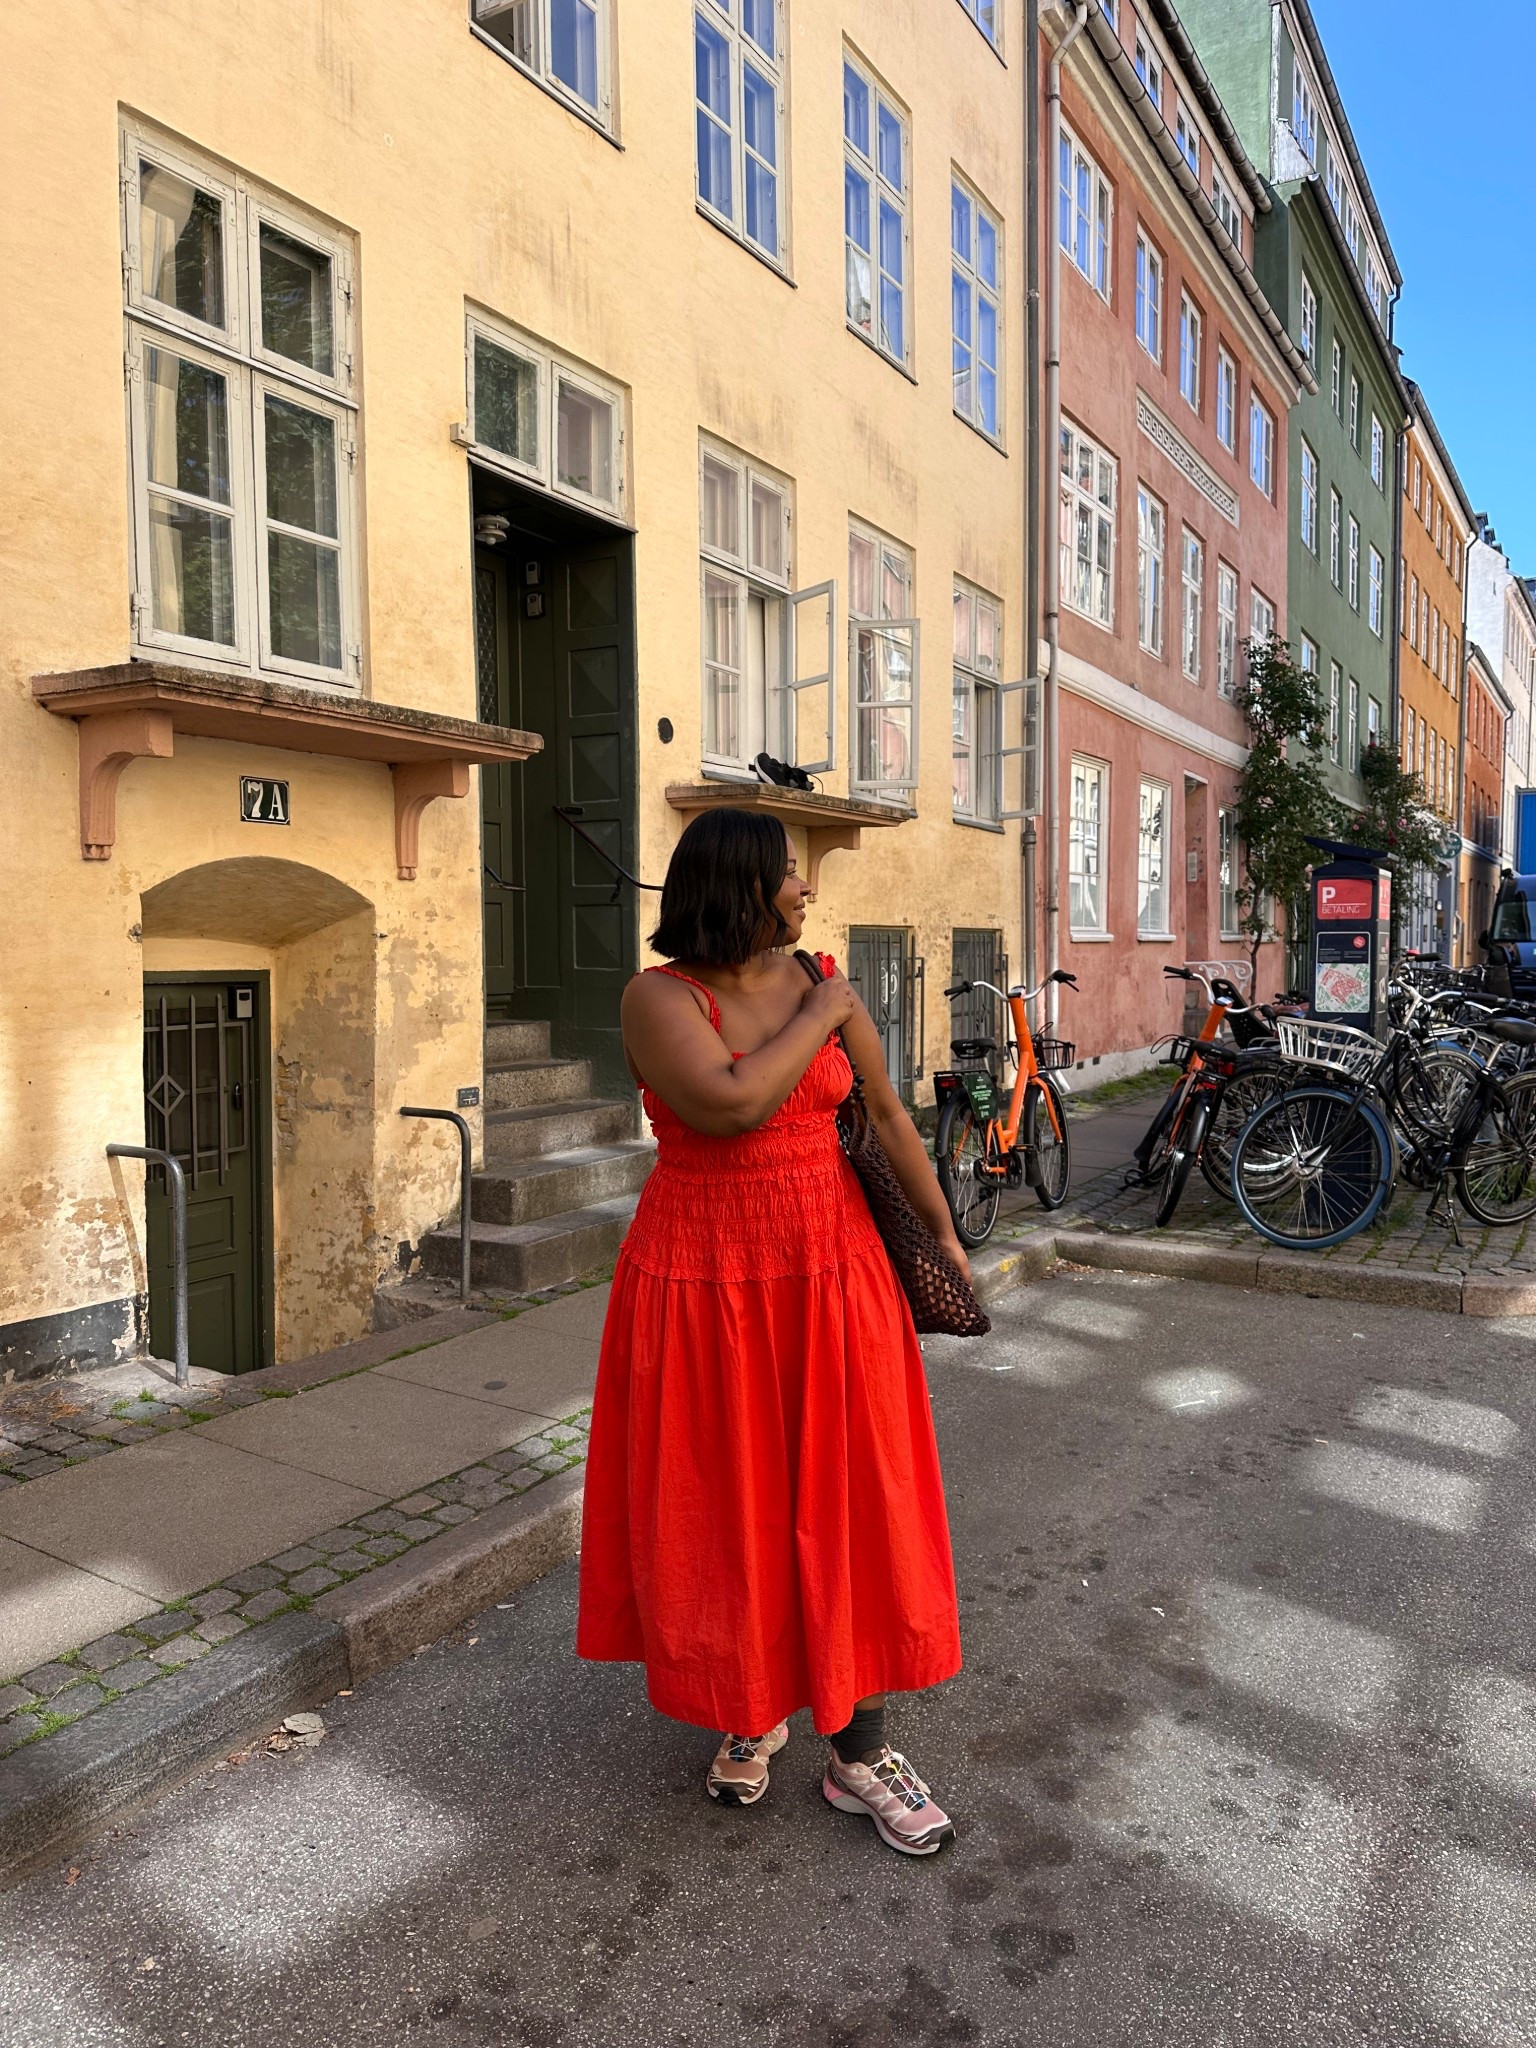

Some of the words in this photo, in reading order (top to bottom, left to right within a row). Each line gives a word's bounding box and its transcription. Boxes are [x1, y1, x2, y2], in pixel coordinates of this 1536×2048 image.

[247, 781, 286, 820] 7A
[1322, 886, 1336, 904] P
[1321, 905, 1360, 914] BETALING
